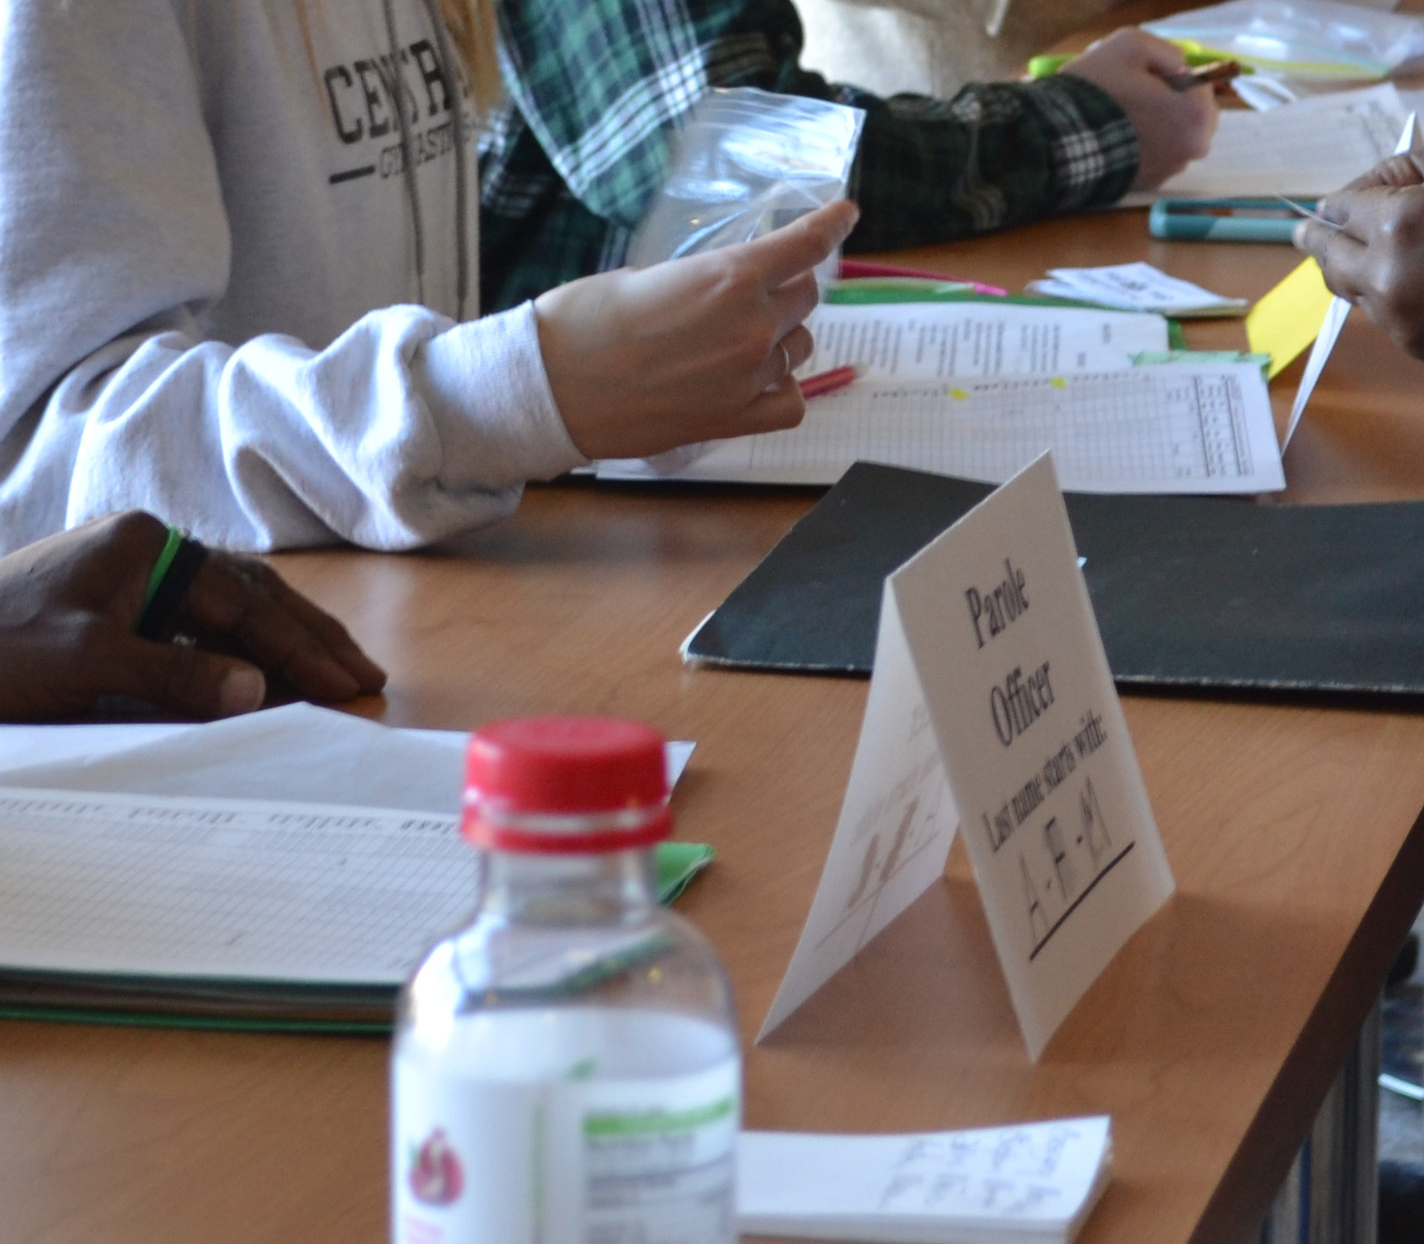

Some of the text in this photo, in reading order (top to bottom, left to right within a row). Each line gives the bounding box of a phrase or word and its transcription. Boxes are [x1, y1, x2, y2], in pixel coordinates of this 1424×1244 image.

[323, 38, 464, 145] CENTR
[965, 558, 1030, 650] Parole
[990, 660, 1057, 748] Officer
[982, 709, 1108, 853] Last name starts with:
